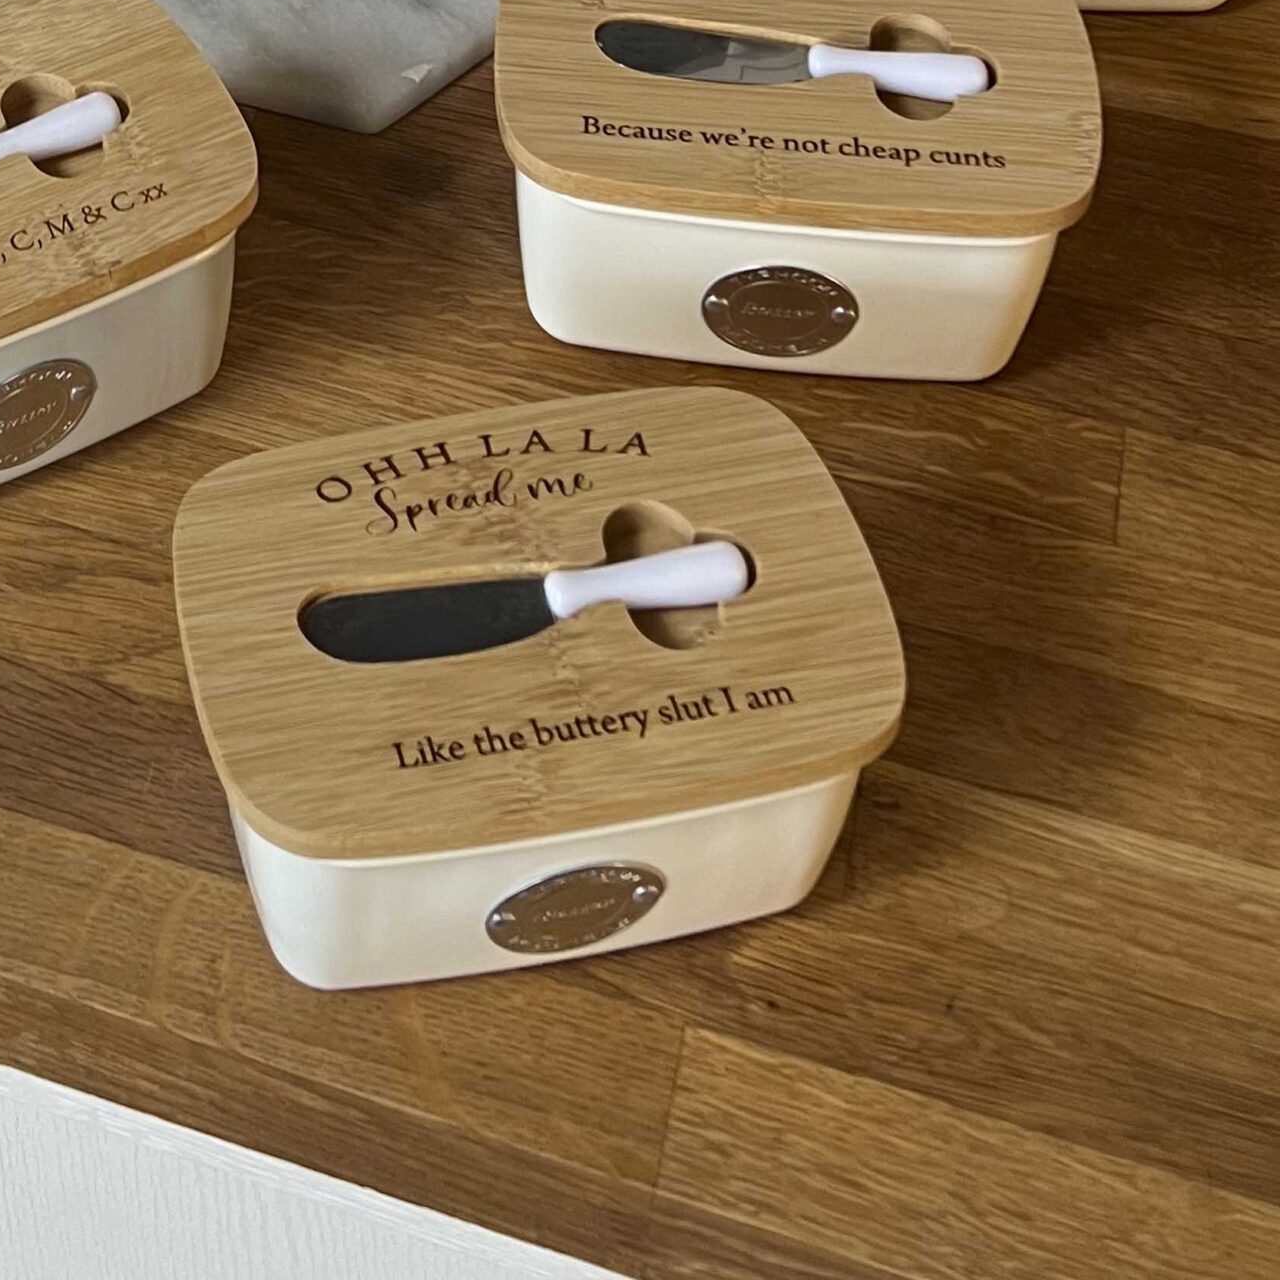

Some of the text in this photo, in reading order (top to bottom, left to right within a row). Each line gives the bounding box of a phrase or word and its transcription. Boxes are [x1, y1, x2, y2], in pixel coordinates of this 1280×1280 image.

[582, 116, 1007, 169] Because we're not cheap cunts
[9, 229, 44, 252] C,
[43, 213, 77, 241] M
[80, 203, 109, 226] &
[111, 190, 138, 212] C
[138, 182, 169, 202] xx
[479, 427, 554, 458] LA
[579, 427, 651, 457] LA
[365, 468, 594, 537] Spread me
[394, 683, 796, 771] Like the buttery slut I am
